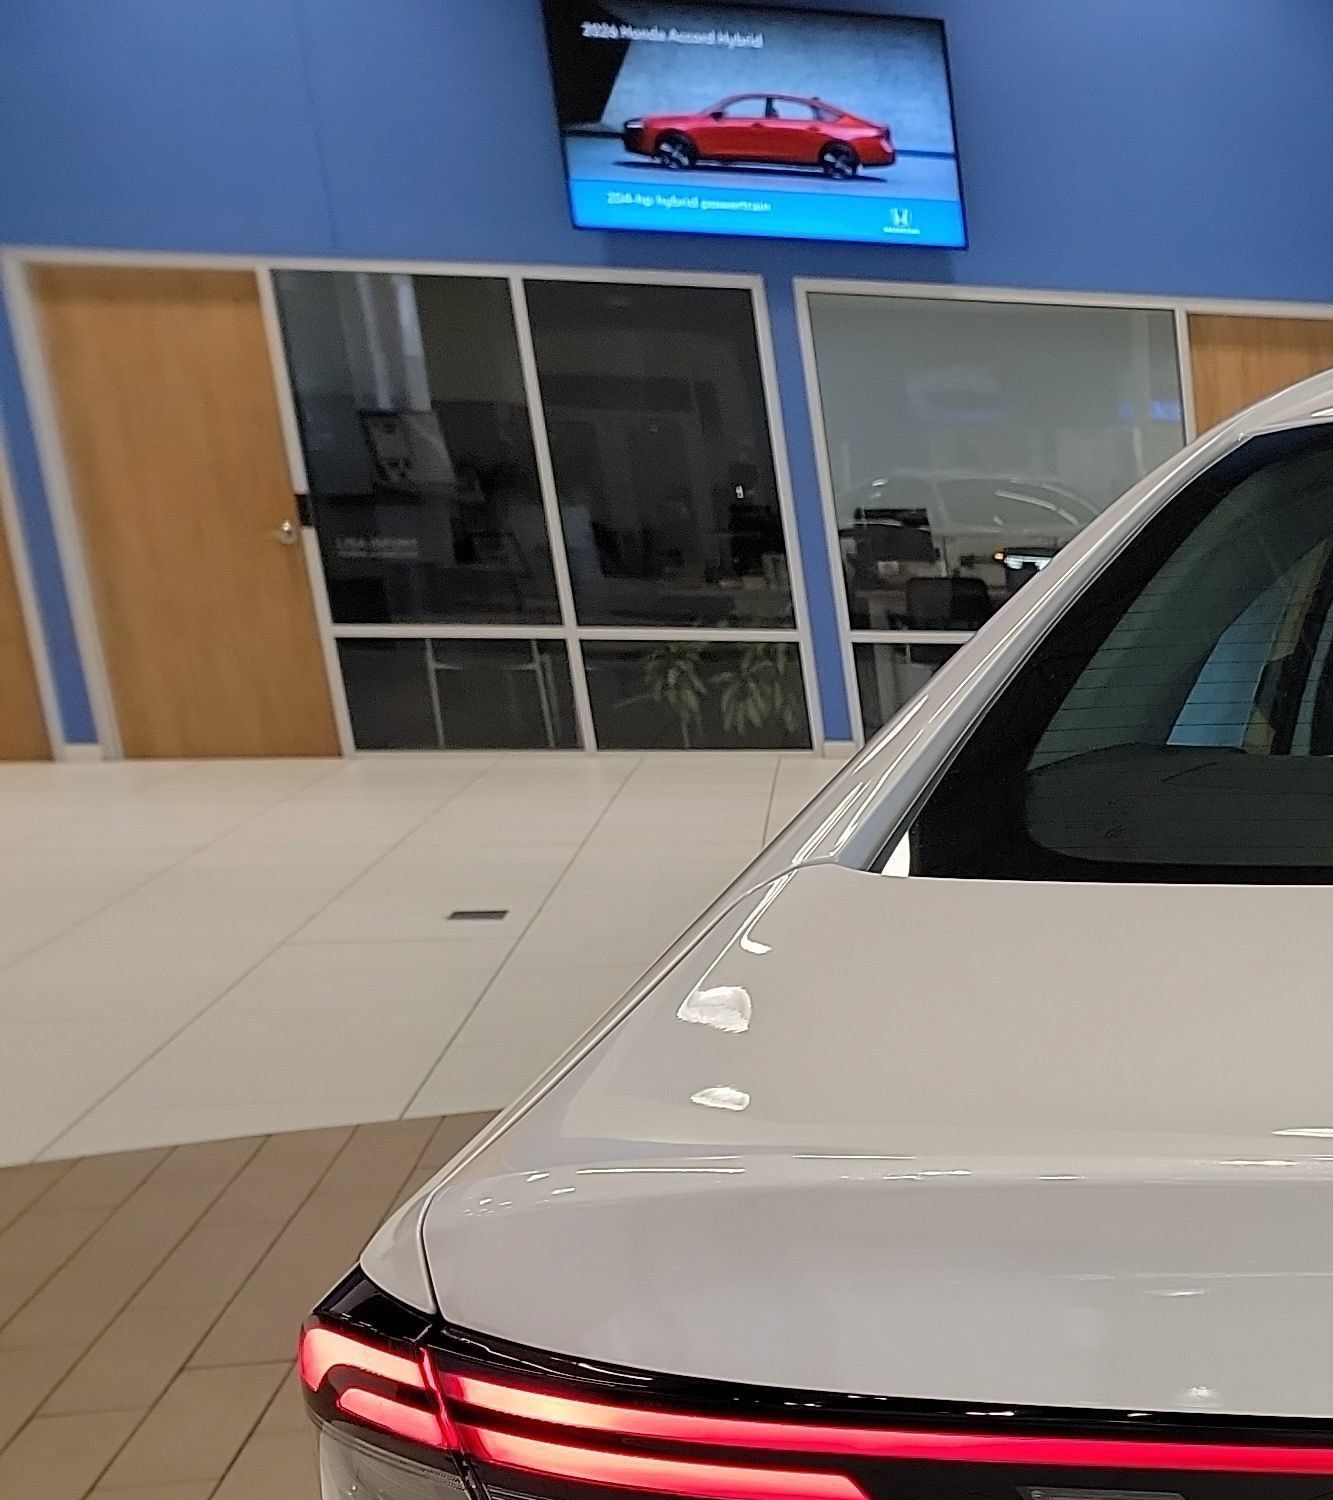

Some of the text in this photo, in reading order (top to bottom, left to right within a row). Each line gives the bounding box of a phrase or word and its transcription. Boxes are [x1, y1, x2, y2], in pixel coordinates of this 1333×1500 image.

[619, 25, 667, 42] Honda
[668, 27, 716, 46] Accord
[717, 29, 764, 49] Hybrid
[656, 194, 699, 209] hybrid
